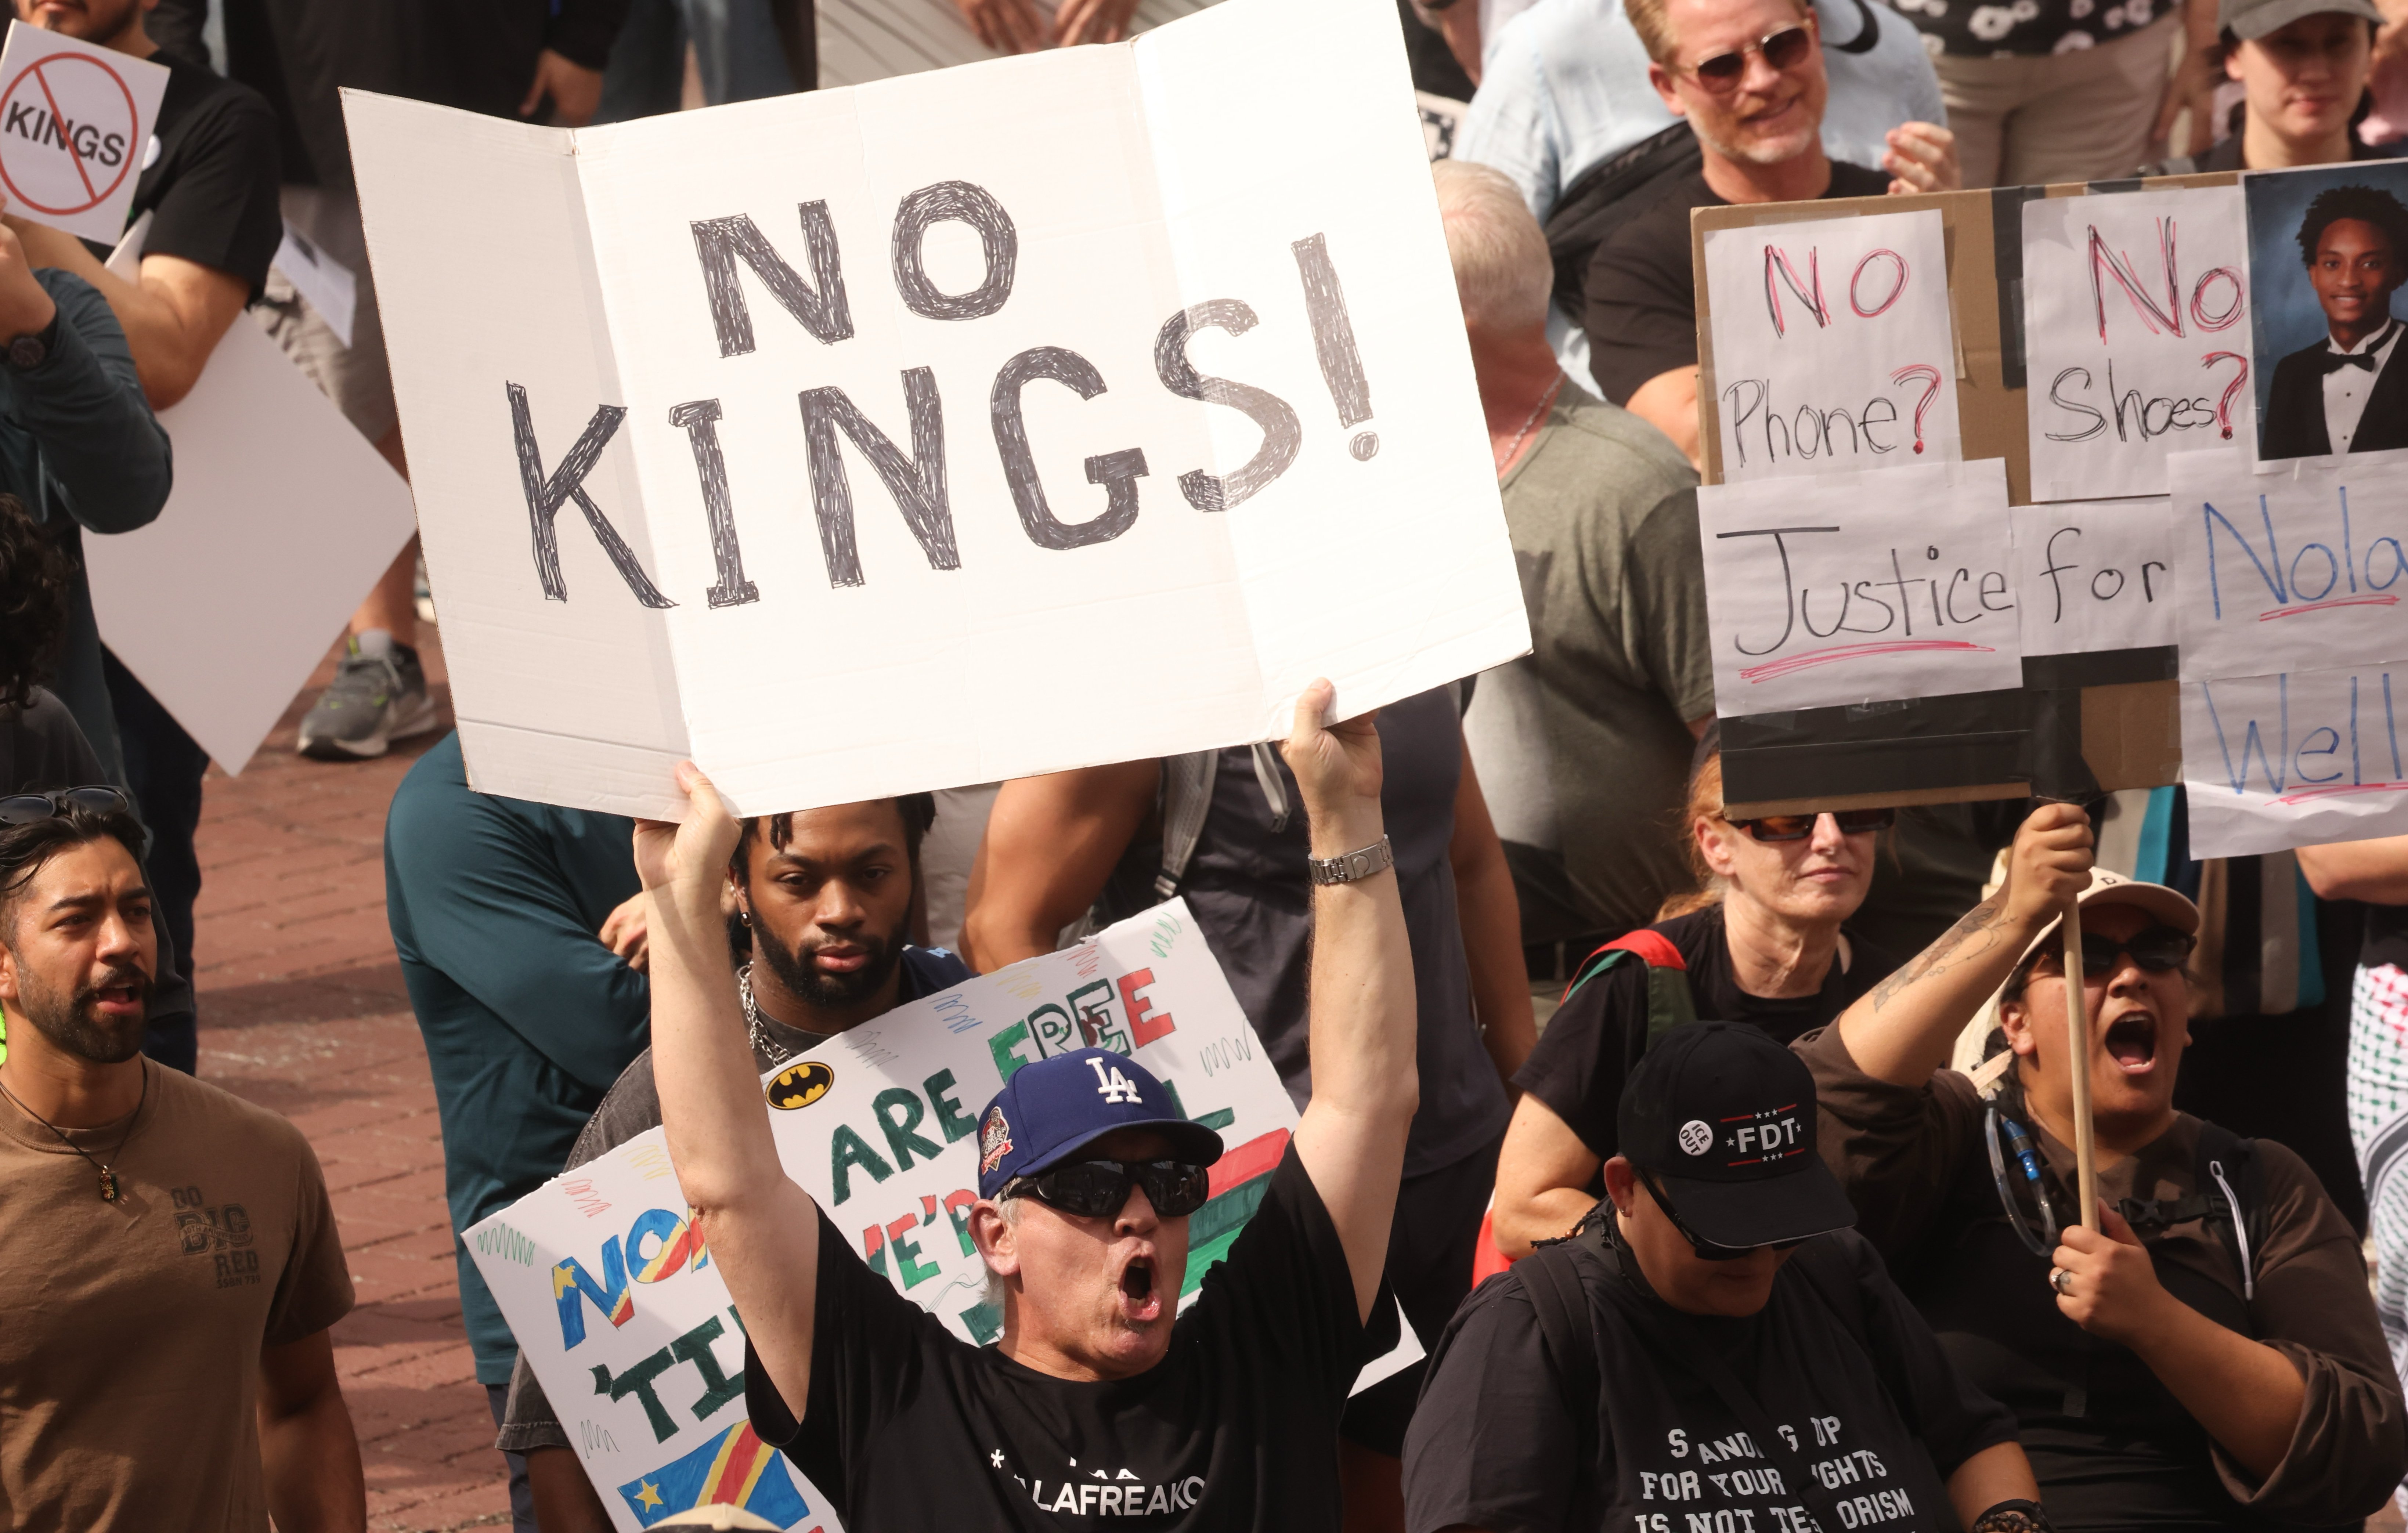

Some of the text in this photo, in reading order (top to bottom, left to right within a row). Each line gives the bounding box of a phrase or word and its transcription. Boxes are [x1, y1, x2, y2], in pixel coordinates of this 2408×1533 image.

[5, 100, 125, 167] KINGS
[690, 180, 1017, 358] NO
[1764, 244, 1909, 339] NO
[507, 233, 1379, 610] KINGS!
[1722, 364, 1942, 467] Phone?
[2045, 351, 2248, 442] Shoes?
[1716, 526, 2014, 655] Justice
[2039, 527, 2167, 623] for
[832, 1068, 977, 1206] ARE
[988, 968, 1177, 1088] FREE
[1086, 1057, 1142, 1104] LA
[983, 1130, 1001, 1149] WORLD
[985, 1138, 1003, 1158] SERIES
[1680, 1129, 1701, 1154] OUT
[1692, 1124, 1709, 1145] ICE
[1737, 1117, 1795, 1153] FDT
[174, 1203, 253, 1256] BIG
[214, 1249, 259, 1276] RED
[588, 1189, 981, 1443] 'TI E'R
[1668, 1416, 1841, 1464] SANDG UP
[1640, 1470, 1701, 1500] FOR
[1708, 1468, 1786, 1497] YOUR
[1635, 1489, 1914, 1533] IS NOT TEORISM
